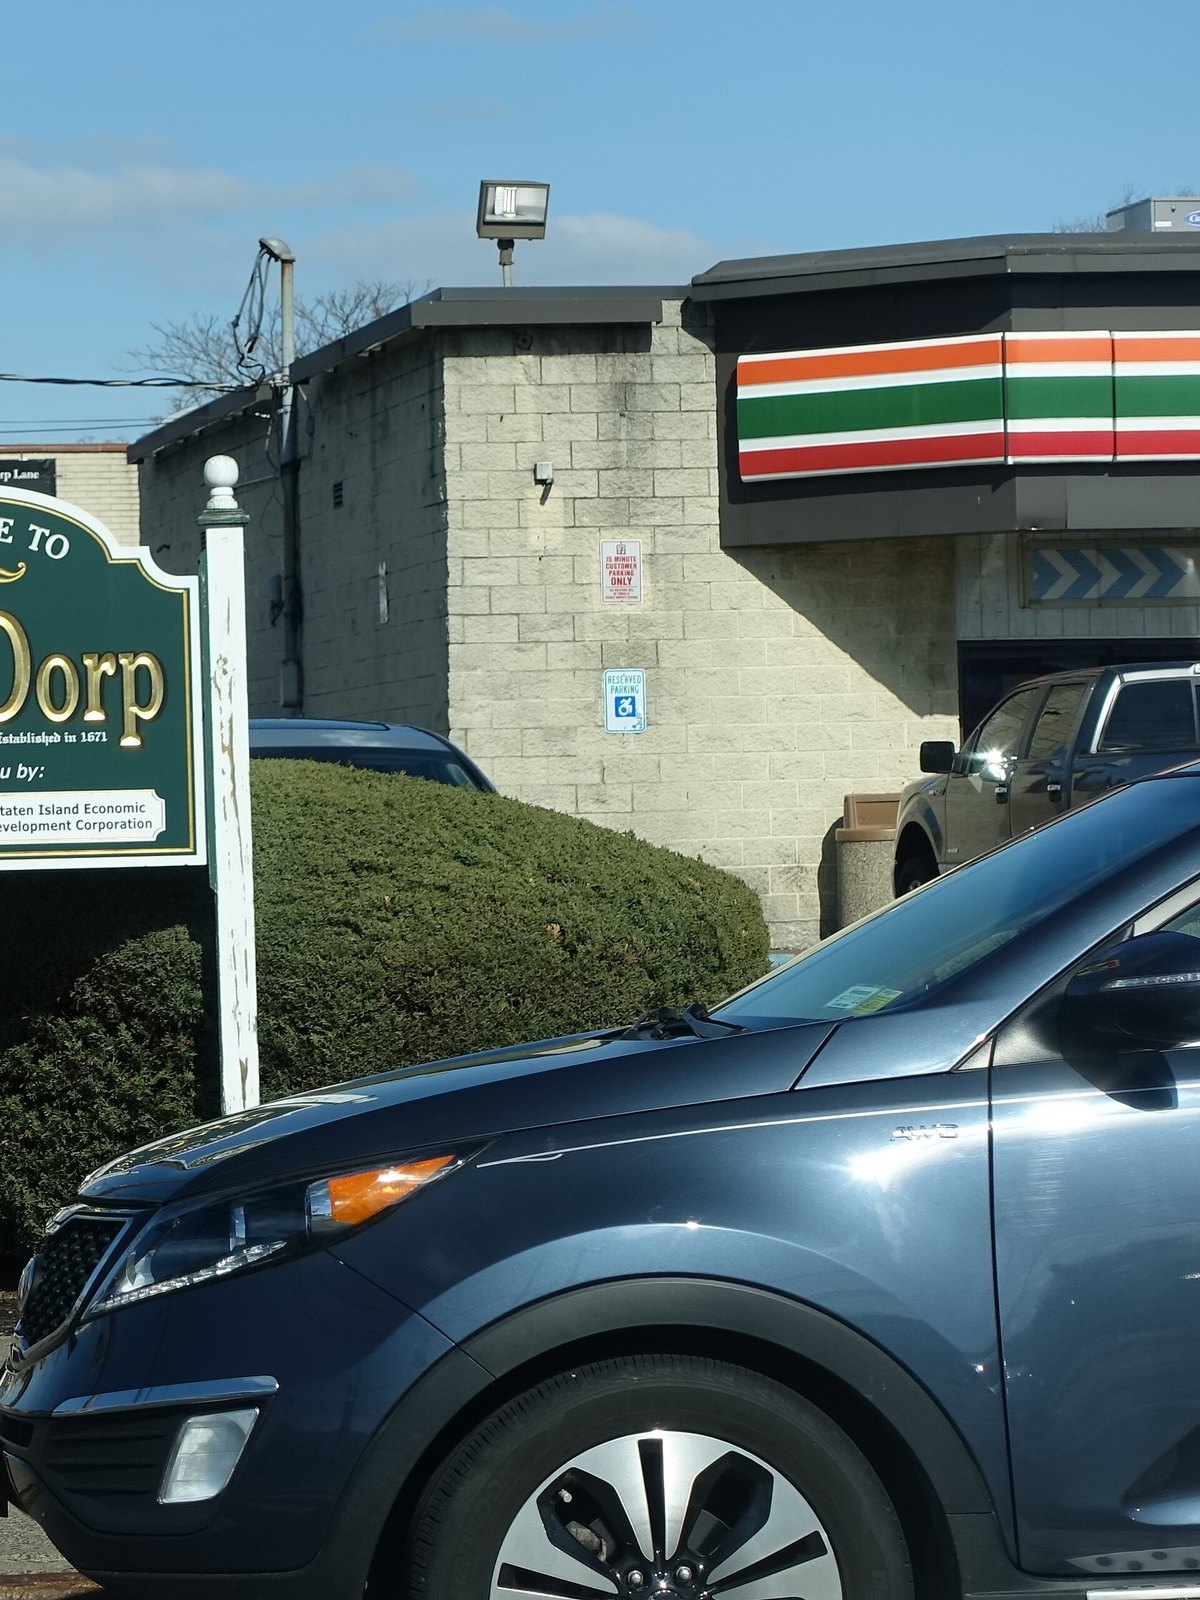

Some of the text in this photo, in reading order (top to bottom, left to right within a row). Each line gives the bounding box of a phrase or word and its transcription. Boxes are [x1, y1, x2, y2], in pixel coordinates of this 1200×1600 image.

[13, 469, 39, 480] Lane
[28, 523, 70, 559] TO
[611, 577, 633, 586] ONLY
[607, 675, 642, 684] RESERVED
[611, 684, 640, 694] PARKING
[64, 732, 76, 744] in
[81, 731, 108, 743] 1671
[16, 763, 45, 782] by:
[38, 803, 79, 816] Island
[84, 801, 146, 815] Economic
[76, 818, 153, 832] Corporation
